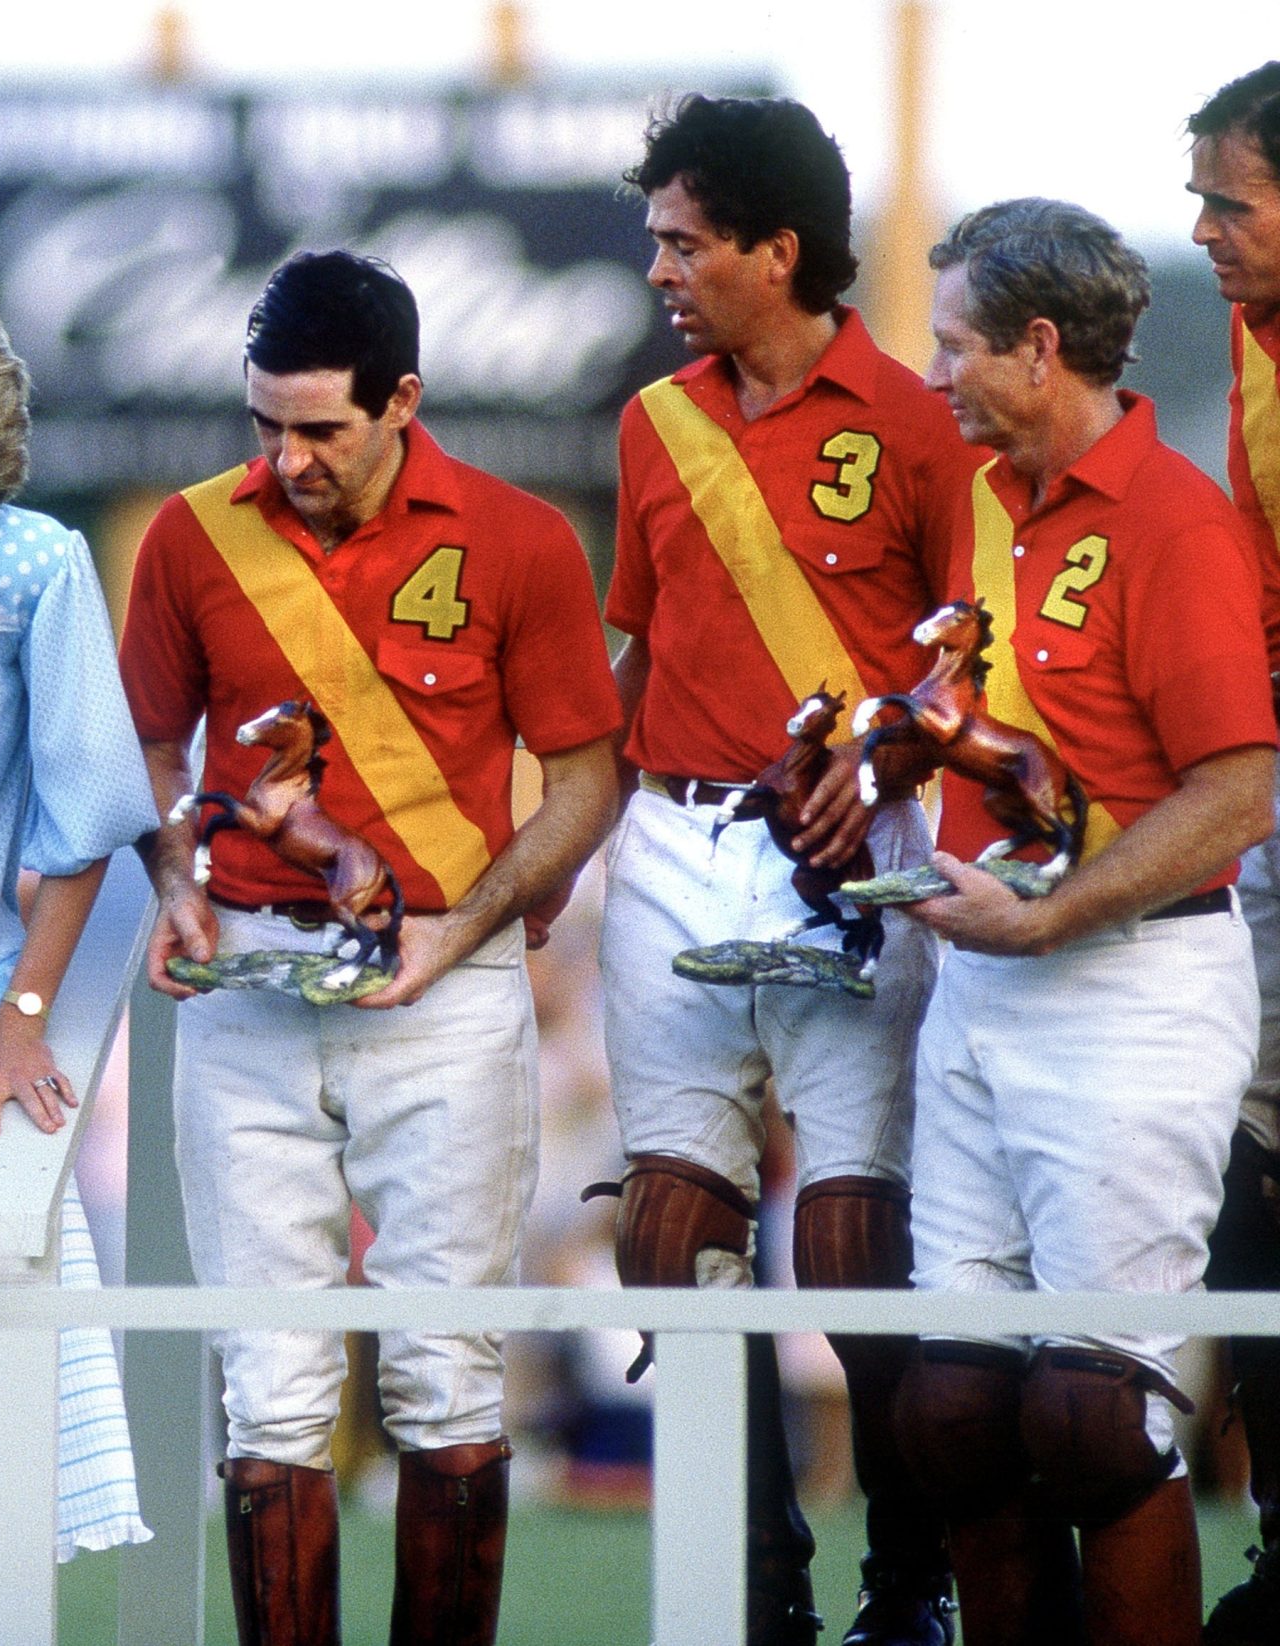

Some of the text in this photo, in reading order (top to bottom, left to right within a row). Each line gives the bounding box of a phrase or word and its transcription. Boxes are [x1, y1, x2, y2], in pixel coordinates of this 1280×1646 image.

[809, 428, 883, 525] 3
[388, 544, 471, 643] 4
[1038, 532, 1112, 631] 2
